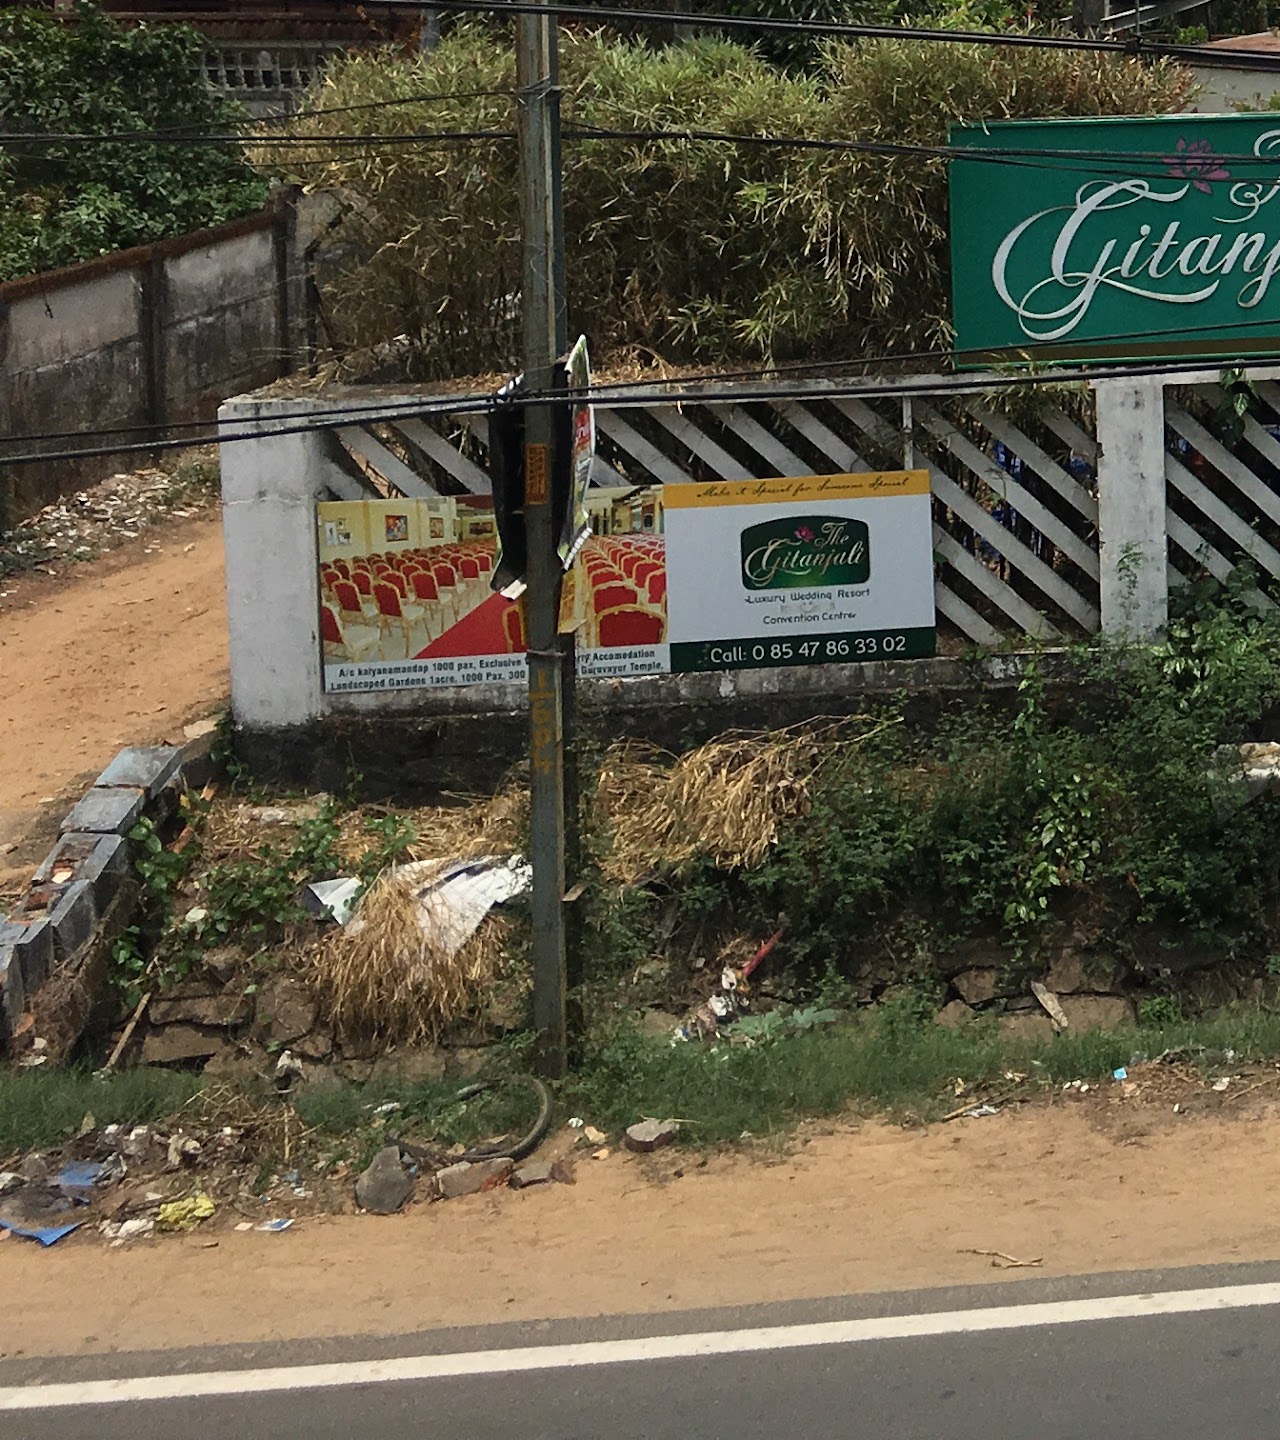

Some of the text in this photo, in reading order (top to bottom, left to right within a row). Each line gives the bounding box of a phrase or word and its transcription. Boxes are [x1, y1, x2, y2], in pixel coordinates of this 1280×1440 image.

[814, 522, 849, 549] The
[744, 538, 864, 587] Gitanjali
[744, 589, 870, 604] Luxury Wedding Resort
[763, 614, 819, 624] Convention
[593, 649, 655, 661] Accomodation
[710, 636, 906, 663] Call: 0 85 47 86 33 02
[339, 668, 354, 677] A/c
[433, 661, 454, 671] 1000
[479, 658, 522, 669] Exclusive
[581, 663, 627, 675] Guruvayur
[331, 679, 385, 692] Landscaped
[388, 676, 426, 687] Gardens
[461, 673, 483, 682] 1000
[508, 670, 526, 680] 300
